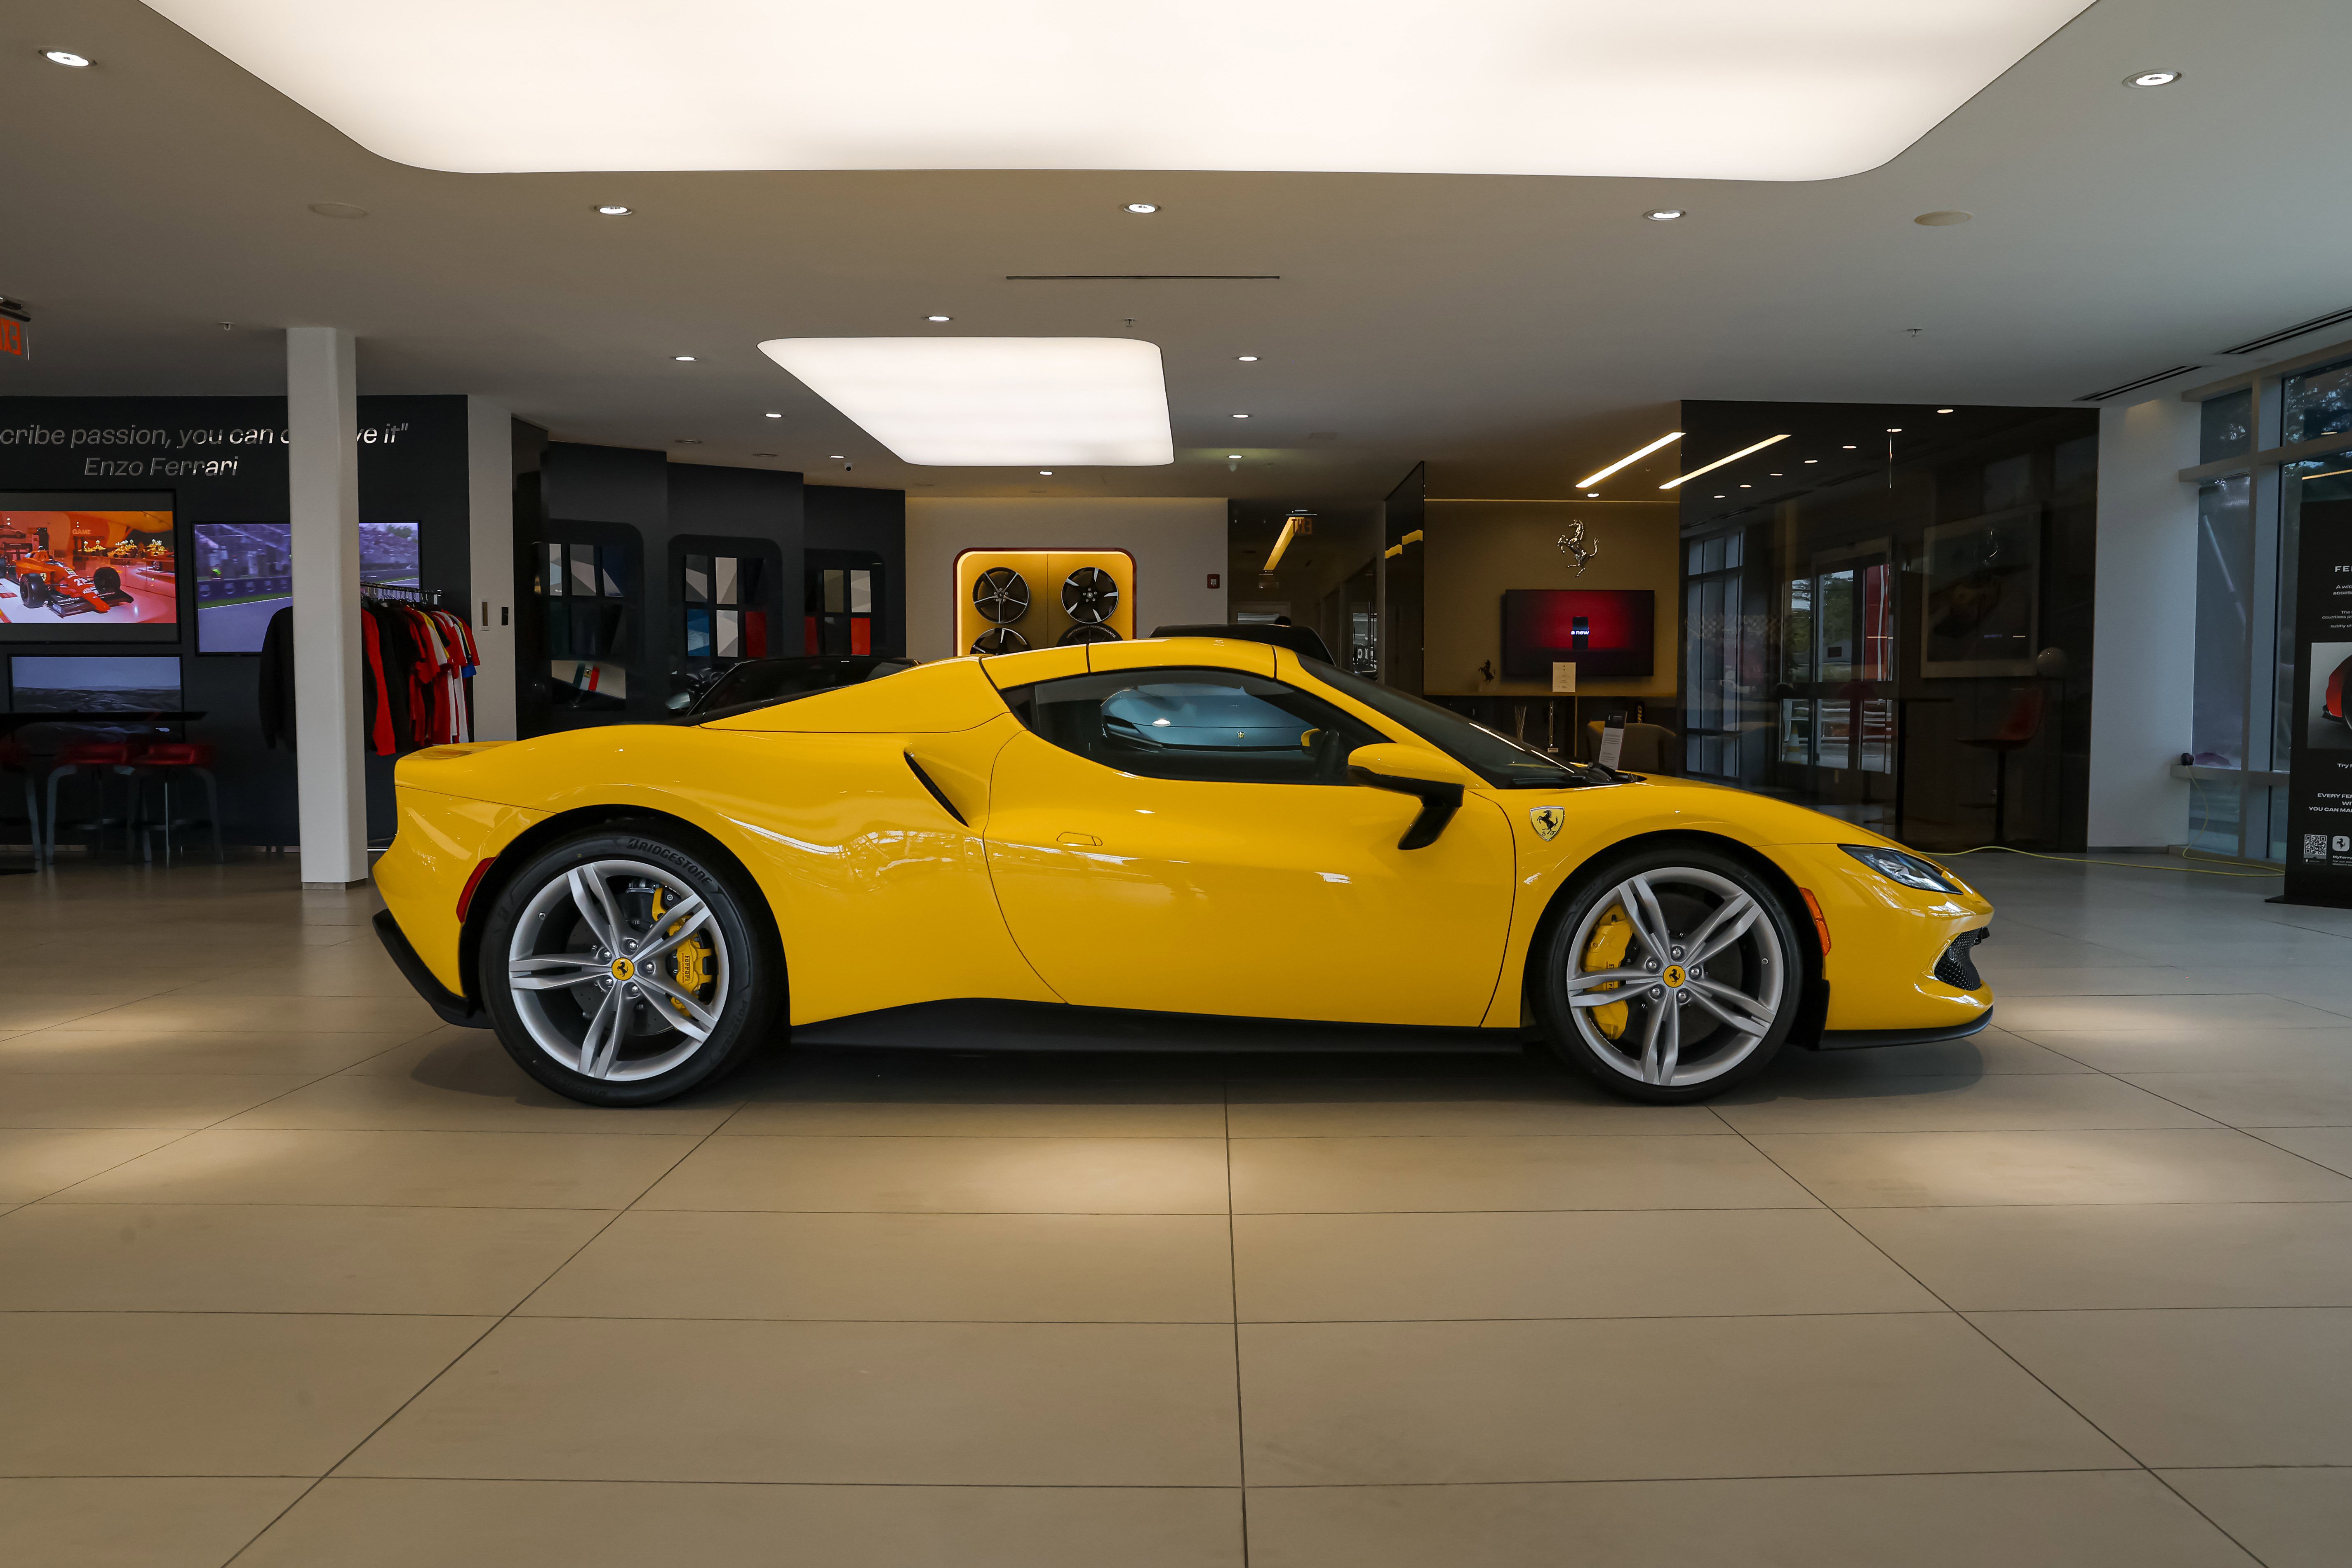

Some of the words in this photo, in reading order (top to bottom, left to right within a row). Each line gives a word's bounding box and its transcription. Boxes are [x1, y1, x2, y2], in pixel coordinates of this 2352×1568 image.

[0, 424, 65, 444] cribe
[71, 424, 172, 449] passion,
[176, 429, 223, 449] you
[229, 429, 273, 444] can
[84, 457, 144, 476] Enzo
[150, 456, 239, 476] Ferrari
[627, 838, 713, 886] BRIDGESTONE
